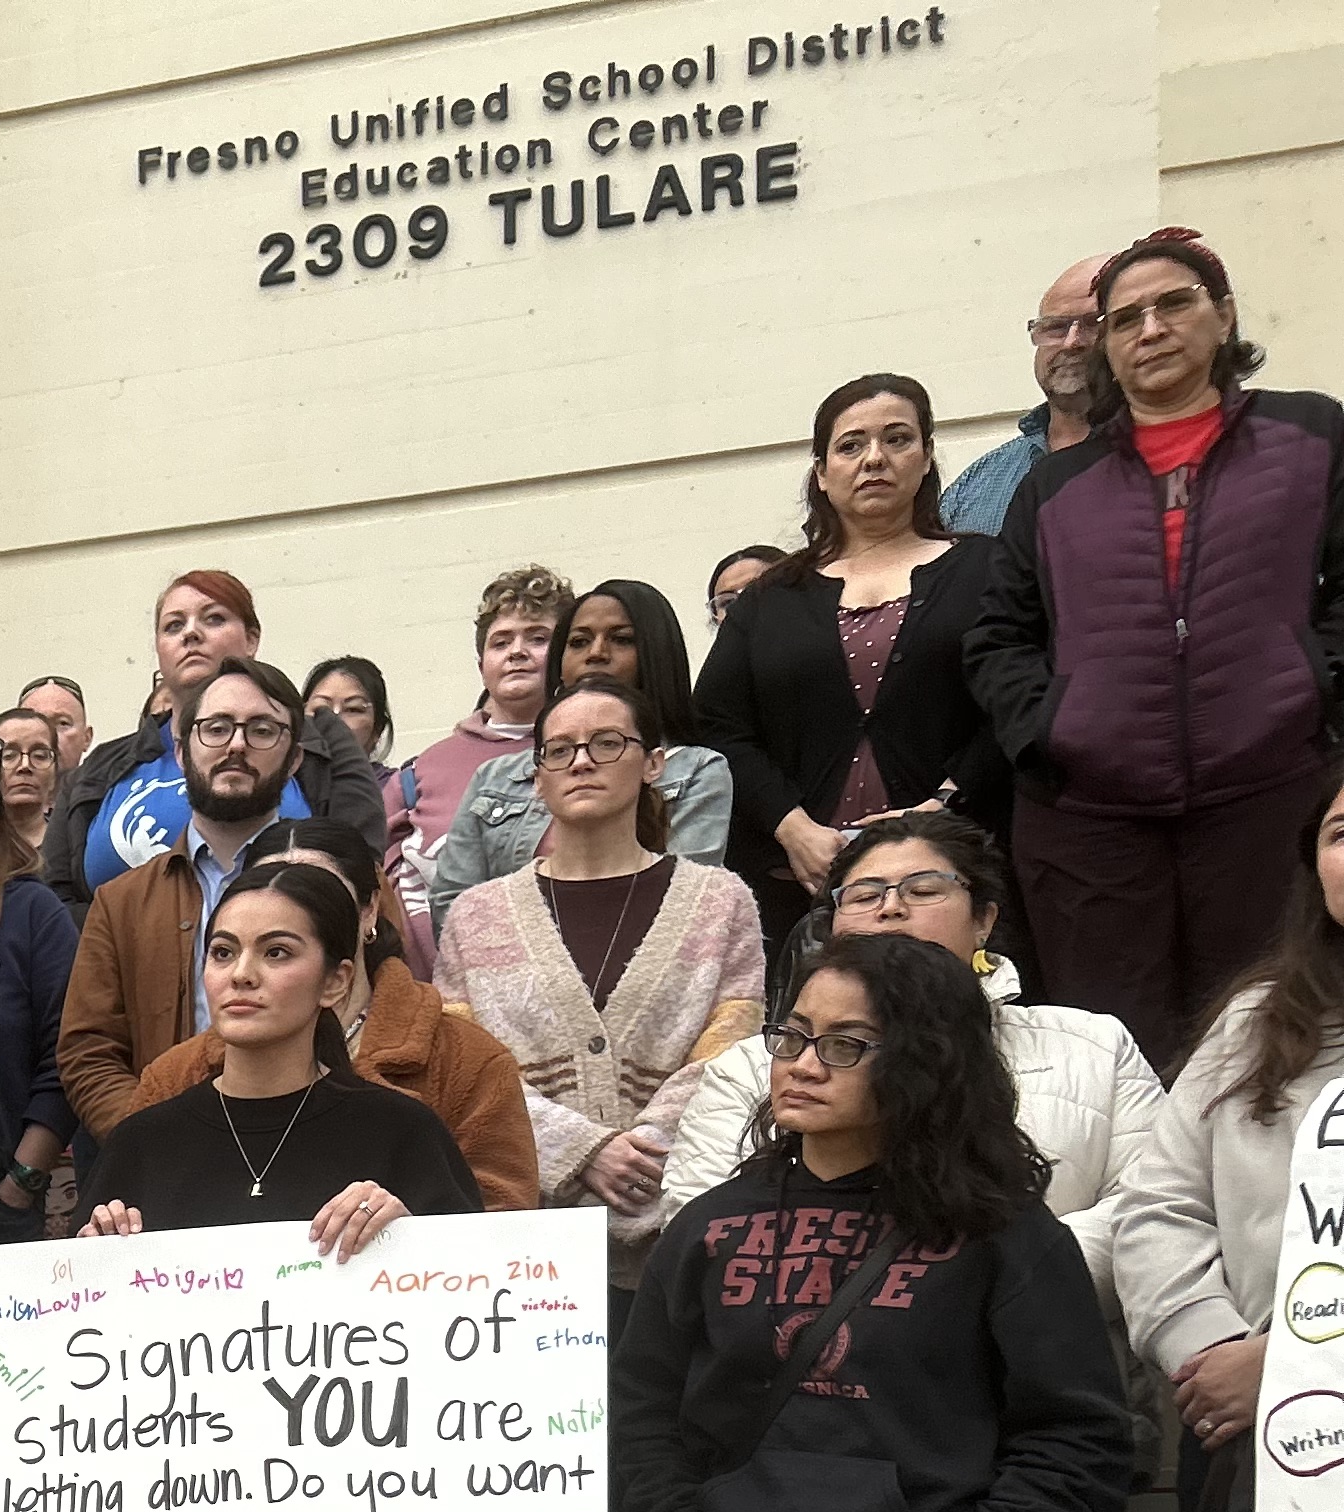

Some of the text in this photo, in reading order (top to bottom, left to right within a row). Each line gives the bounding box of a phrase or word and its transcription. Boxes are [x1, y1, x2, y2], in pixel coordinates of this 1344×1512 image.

[138, 6, 946, 187] Fresno Unified School District
[301, 96, 771, 209] Education Center
[258, 142, 800, 288] 2309 TULARE
[369, 1268, 490, 1294] Aaron
[506, 1255, 559, 1282] Zion
[720, 1256, 929, 1309] STAE
[66, 1287, 517, 1418] Signatures of
[536, 1327, 607, 1352] Ethan
[262, 1373, 409, 1448] YOU
[436, 1399, 533, 1442] are
[147, 1458, 253, 1511] down.
[263, 1457, 325, 1504] Do
[466, 1454, 595, 1497] want
